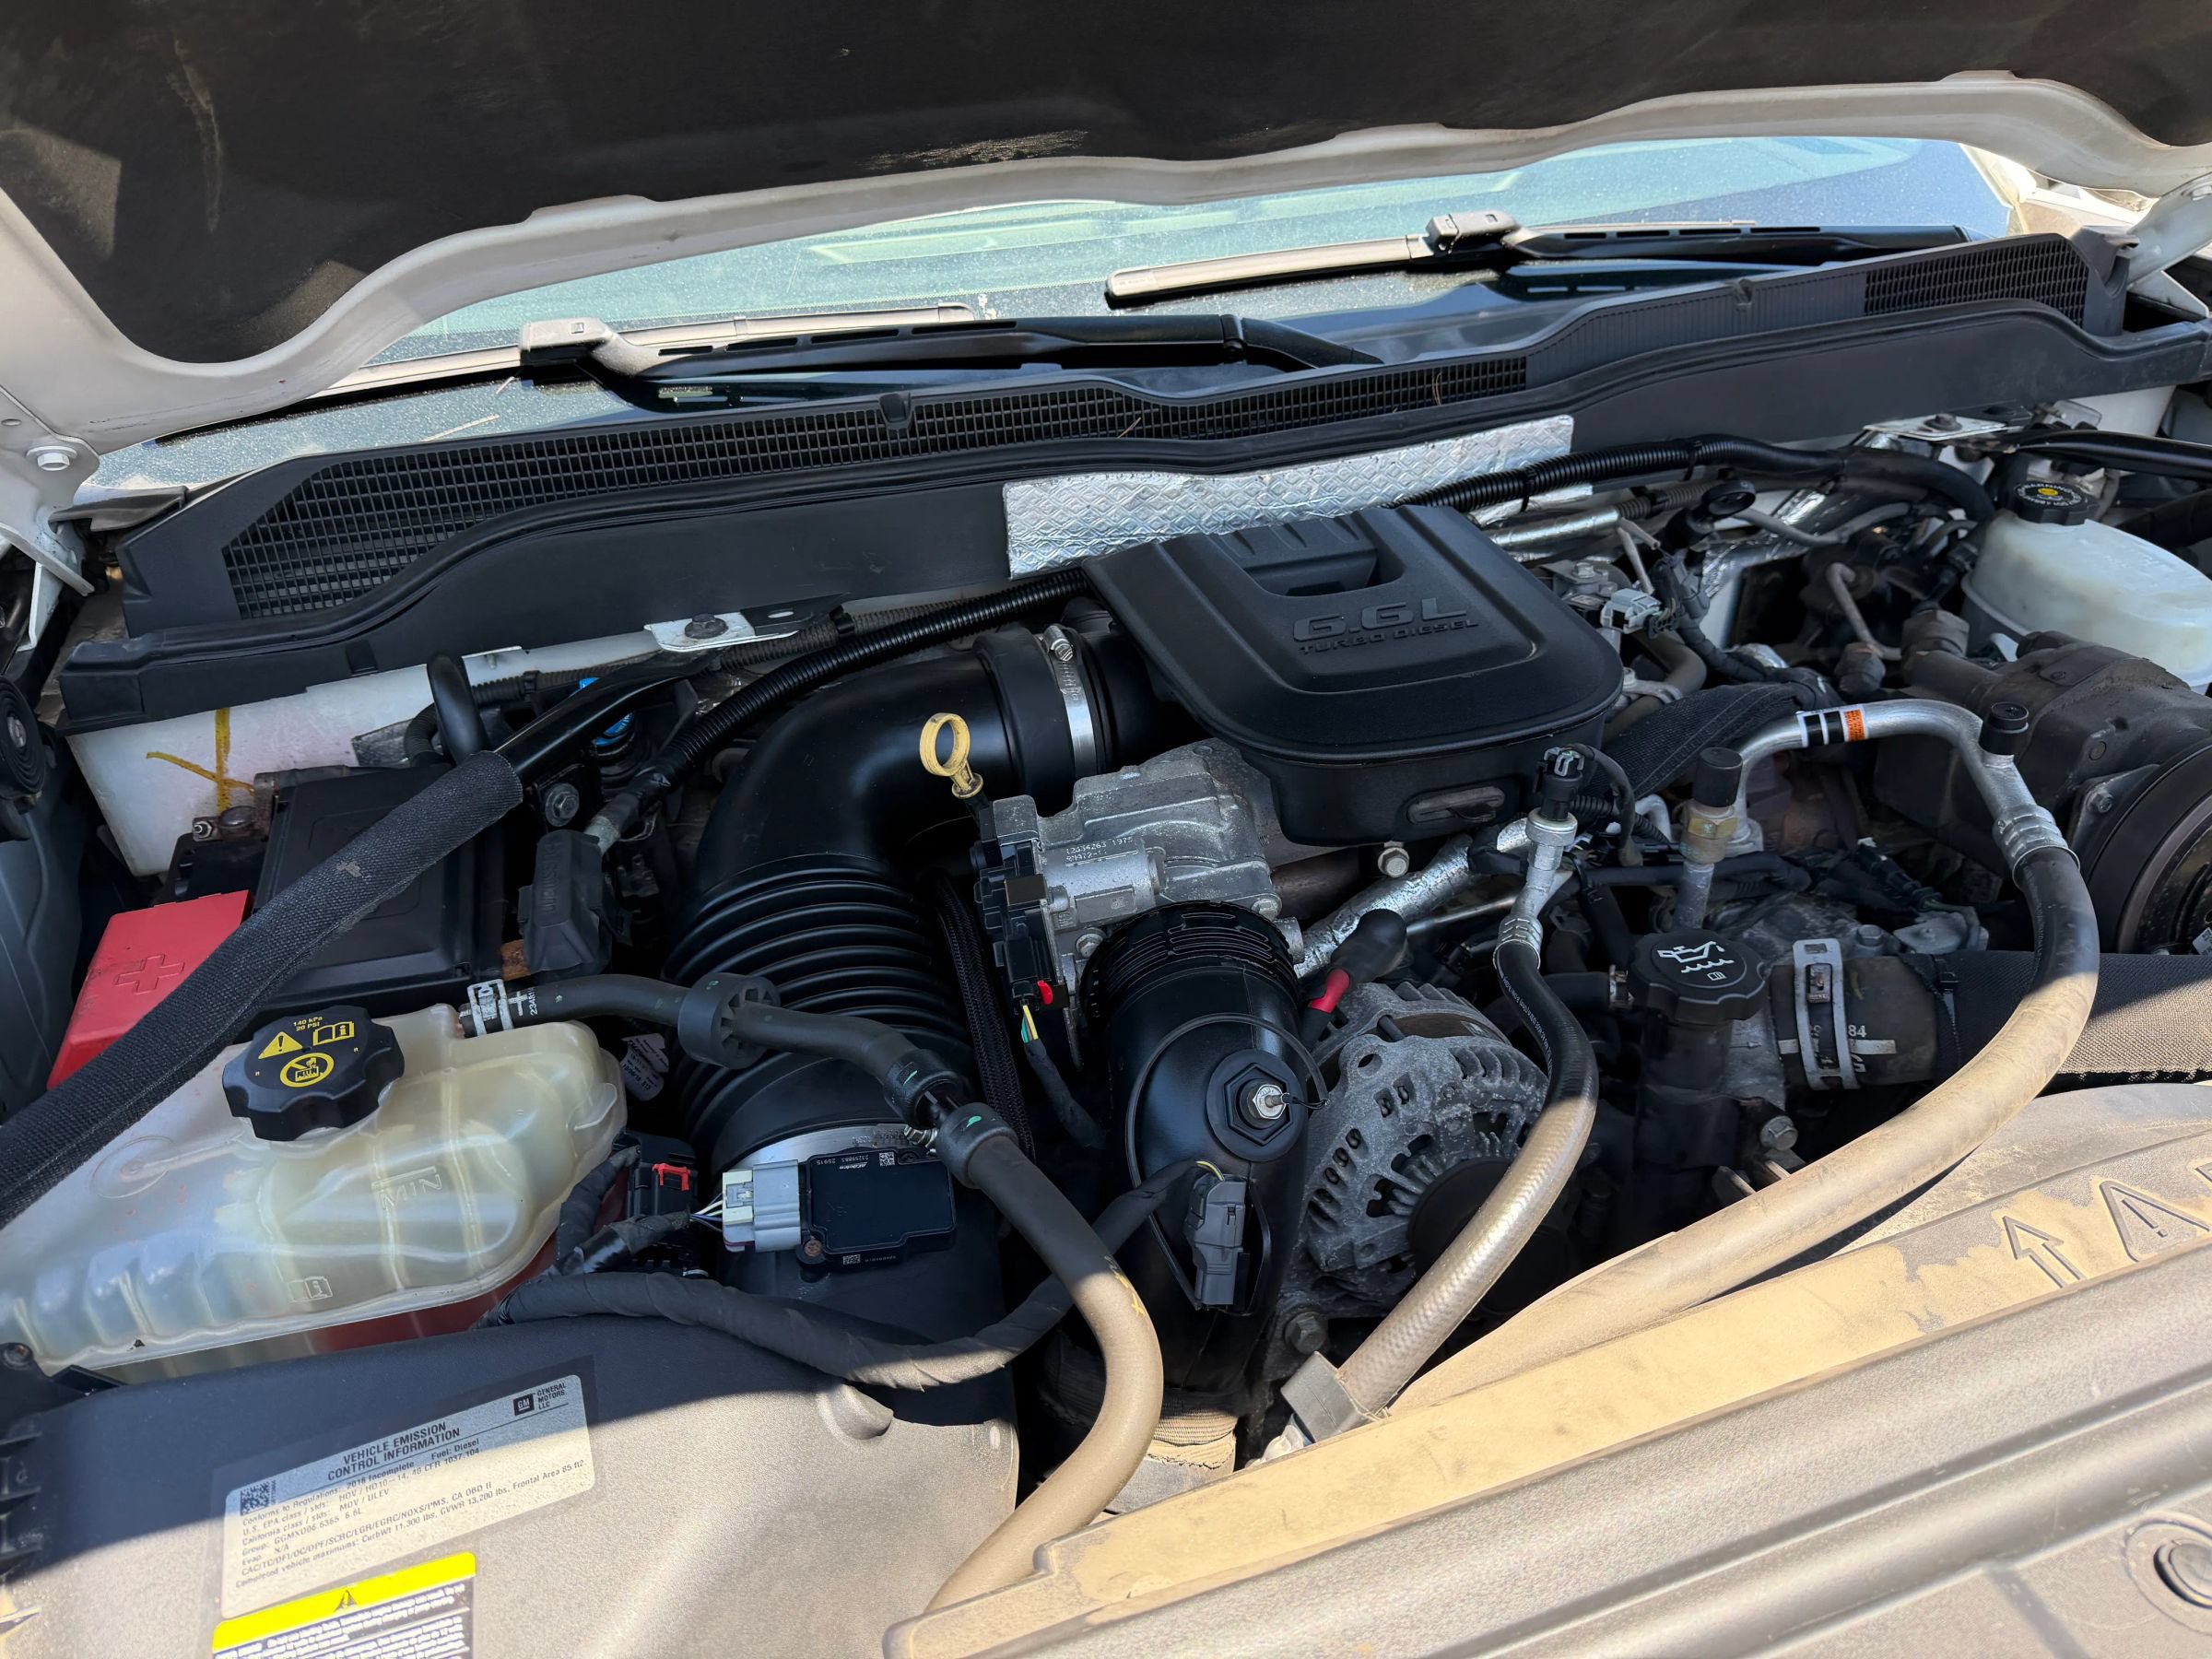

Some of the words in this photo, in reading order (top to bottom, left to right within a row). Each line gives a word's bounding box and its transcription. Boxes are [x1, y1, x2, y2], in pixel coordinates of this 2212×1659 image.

[1294, 597, 1466, 642] 6.6L
[1300, 634, 1384, 654] TURBO
[1394, 618, 1478, 640] DIESEL
[307, 1021, 320, 1030] PSI
[309, 1016, 323, 1024] kPa
[536, 1382, 567, 1396] GENERAL
[538, 1390, 566, 1403] MOTORS
[538, 1401, 551, 1410] LLC
[328, 1456, 380, 1481] CONTROL
[383, 1428, 461, 1461] INFORMATION
[343, 1442, 389, 1465] VEHICLE
[394, 1422, 446, 1447] EMISSION
[242, 1509, 279, 1525] Conforms
[369, 1461, 415, 1481] Incomplete
[431, 1447, 452, 1460] Fuel:
[454, 1438, 479, 1453] Diesel
[264, 1517, 279, 1528] EPA
[282, 1510, 301, 1522] class
[424, 1460, 441, 1472] CFR
[452, 1491, 463, 1501] CA
[235, 1568, 278, 1587] Completed
[281, 1556, 311, 1571] vehicle
[440, 1501, 465, 1515] GVWR
[512, 1475, 539, 1489] Frontal
[542, 1468, 559, 1479] Area
[242, 1527, 280, 1546] California
[283, 1519, 302, 1531] class
